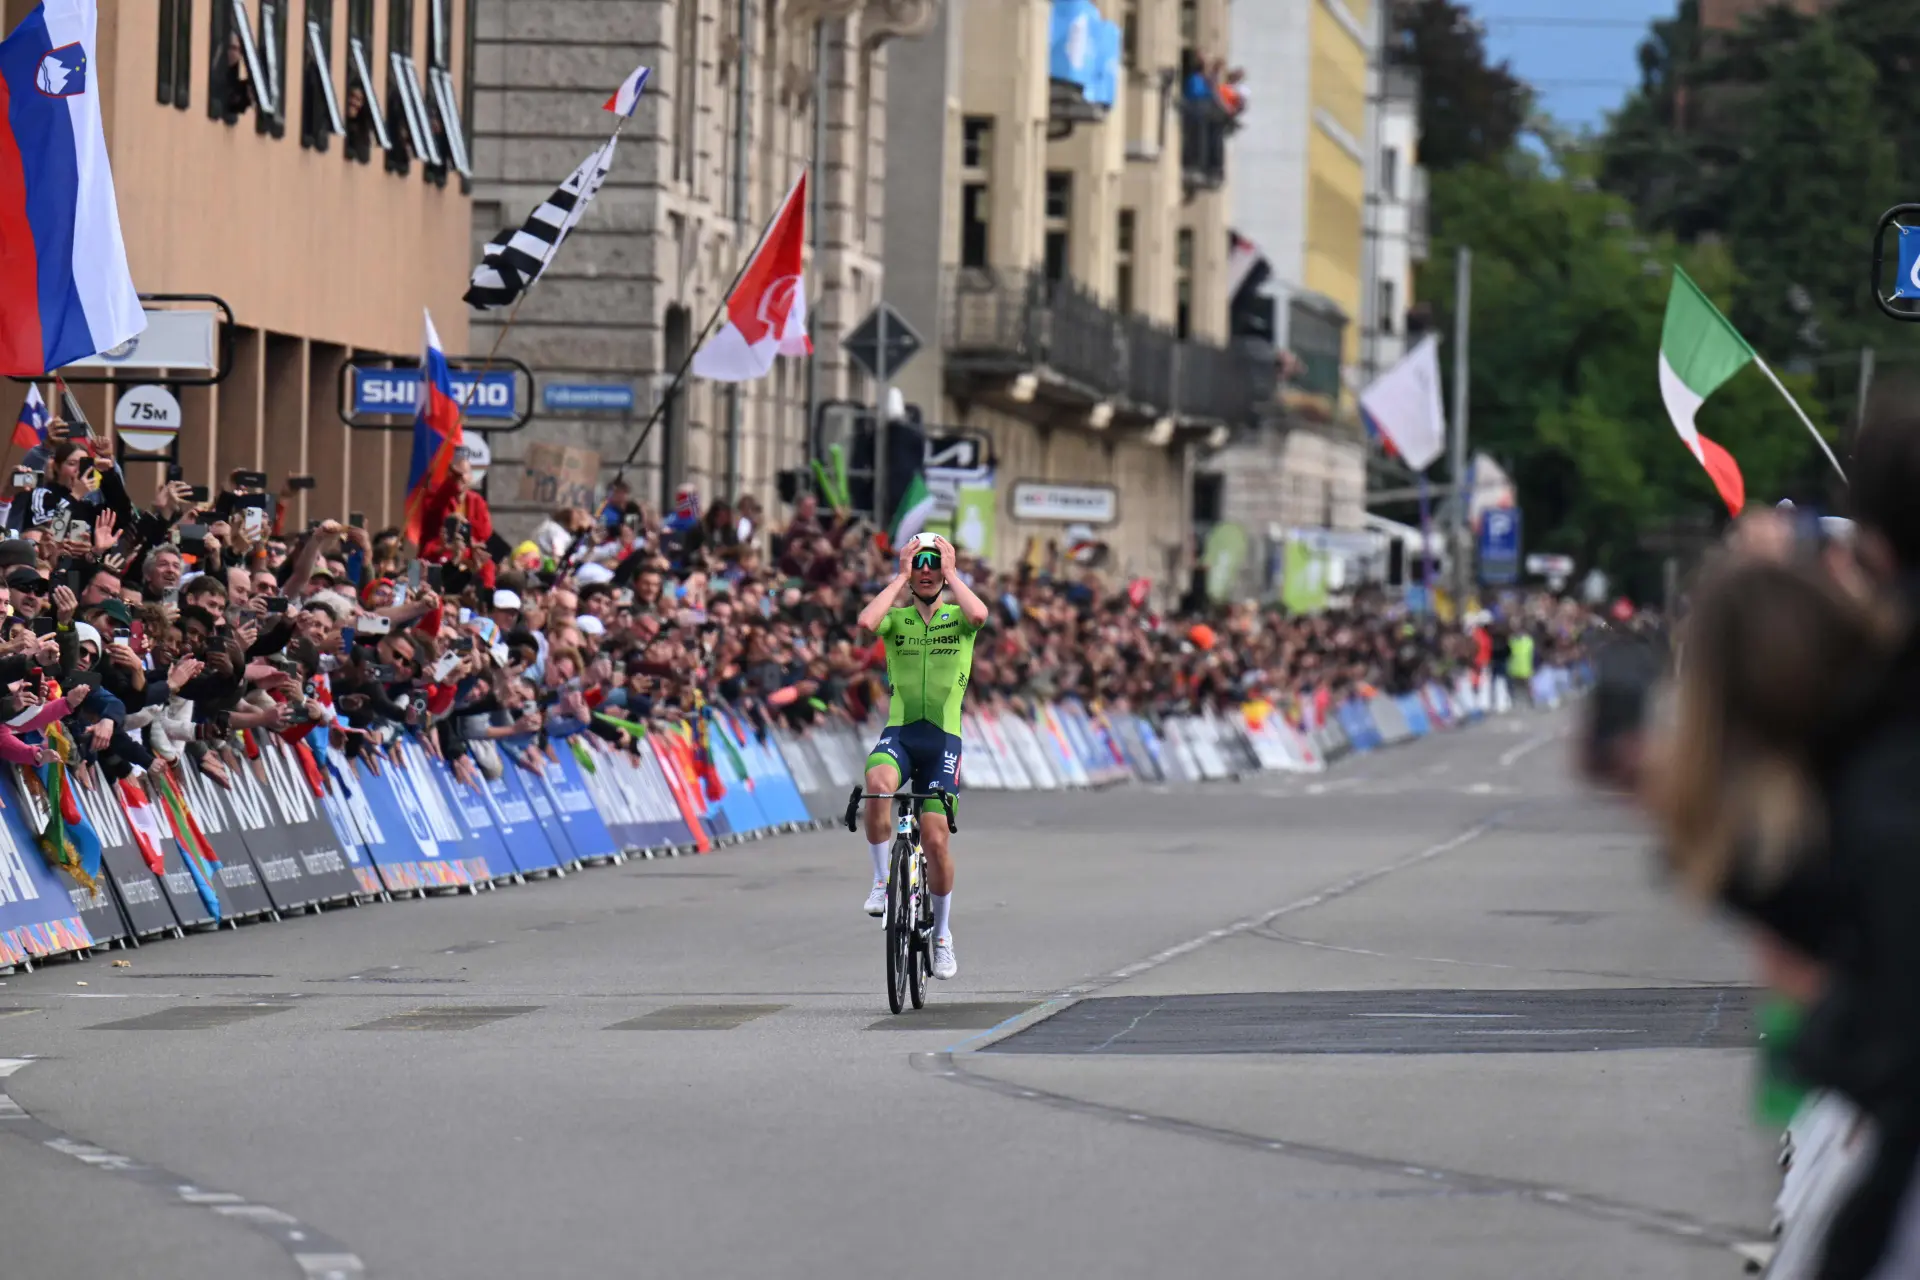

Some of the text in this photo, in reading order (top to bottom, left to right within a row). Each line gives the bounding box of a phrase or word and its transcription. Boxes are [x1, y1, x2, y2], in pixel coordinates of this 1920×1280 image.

[362, 379, 509, 406] SHIANO
[130, 402, 168, 421] 75M
[929, 619, 959, 632] CORWIN
[943, 751, 957, 774] UAE
